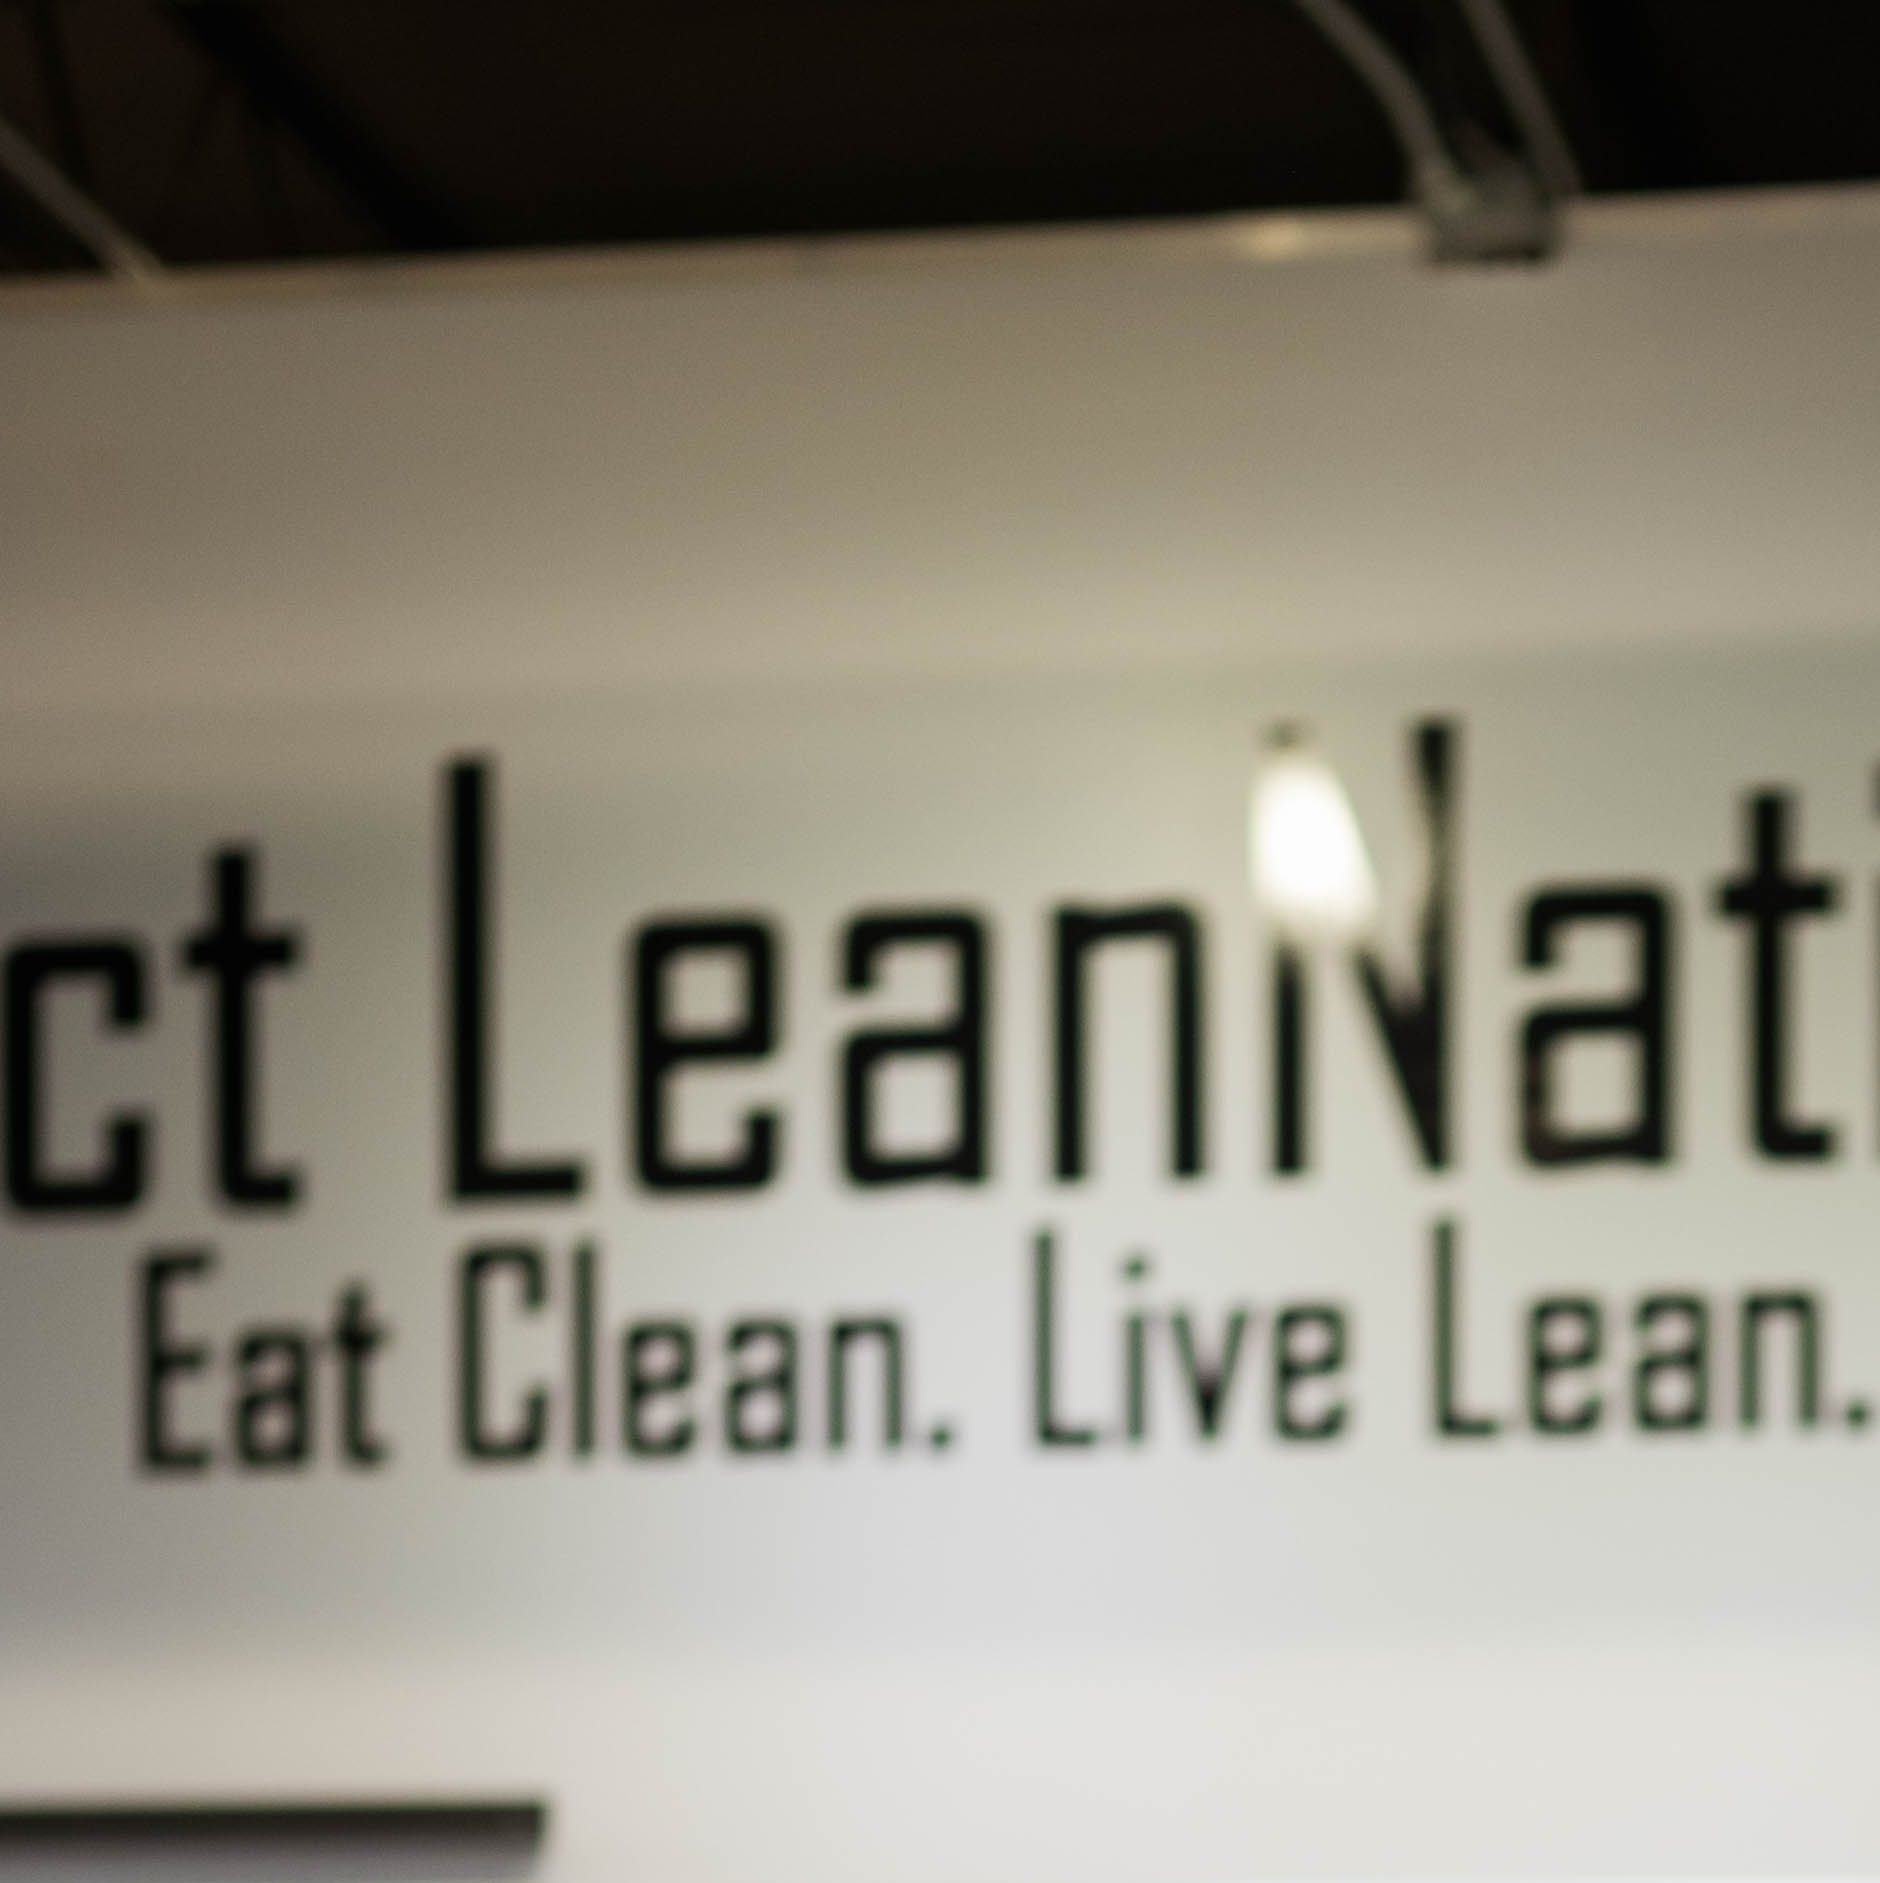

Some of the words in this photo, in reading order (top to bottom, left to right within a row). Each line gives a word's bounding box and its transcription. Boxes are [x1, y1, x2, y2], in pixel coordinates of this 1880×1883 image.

[137, 1244, 387, 1472] Eat
[456, 1234, 955, 1466] Clean.
[1034, 1224, 1350, 1447] Live
[1430, 1216, 1876, 1440] Lean.
